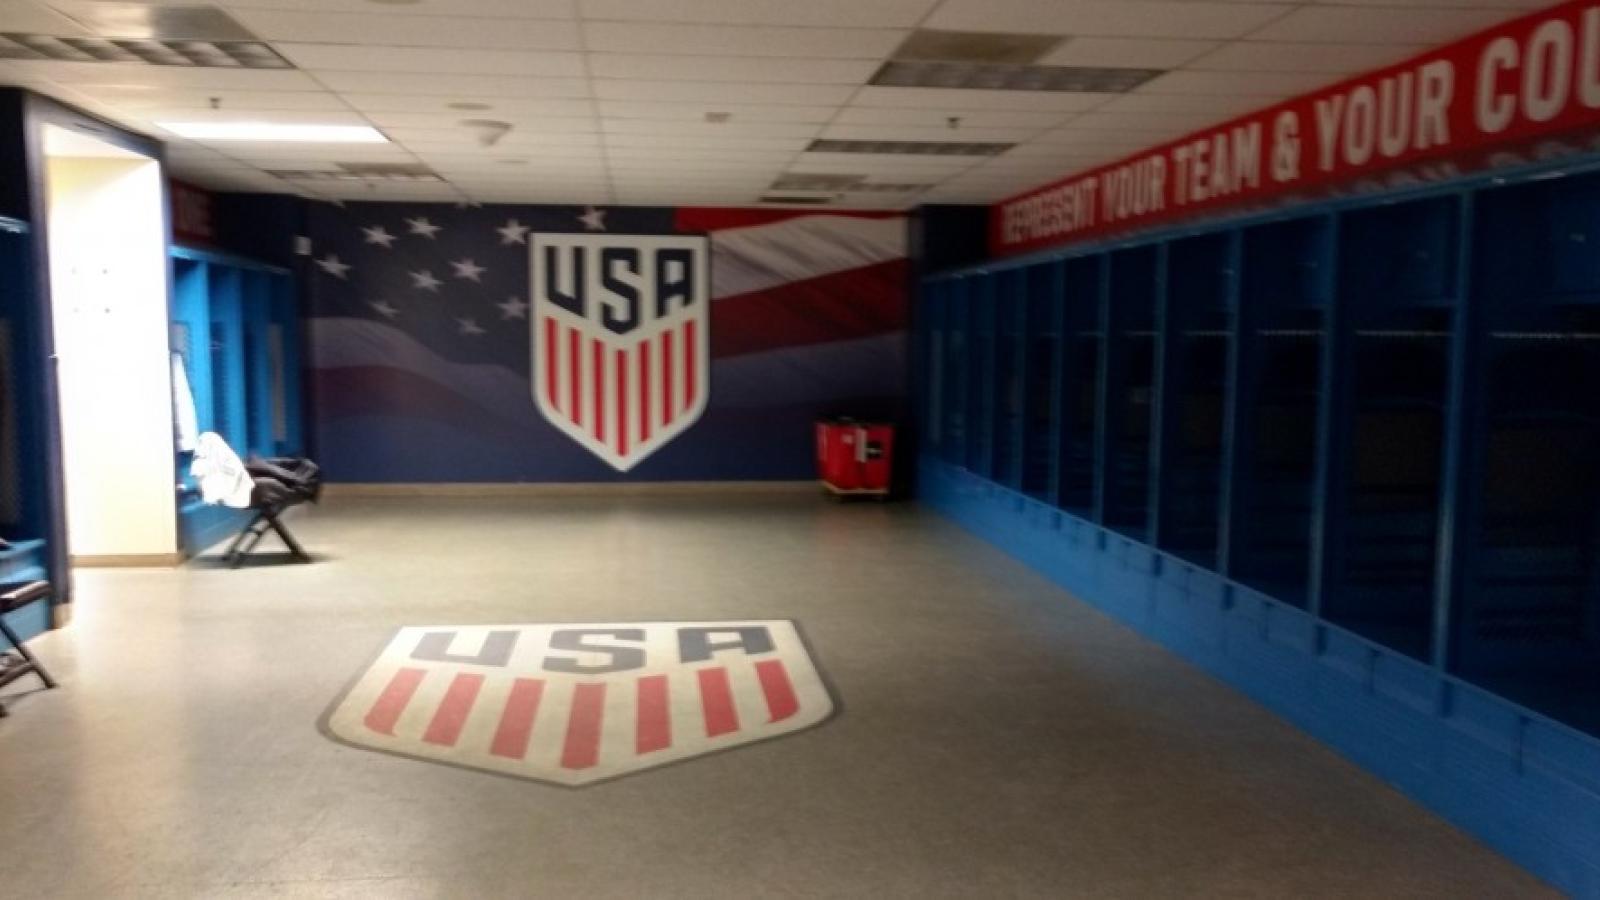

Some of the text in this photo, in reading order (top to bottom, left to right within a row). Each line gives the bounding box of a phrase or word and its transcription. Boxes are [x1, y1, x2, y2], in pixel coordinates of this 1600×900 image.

[1003, 178, 1097, 243] REPRESENT
[1103, 156, 1166, 222] YOUR
[1173, 124, 1262, 205] TEAM
[1272, 111, 1299, 182] &
[1314, 60, 1454, 170] YOUR
[545, 246, 694, 334] USA
[410, 626, 775, 674] USA
